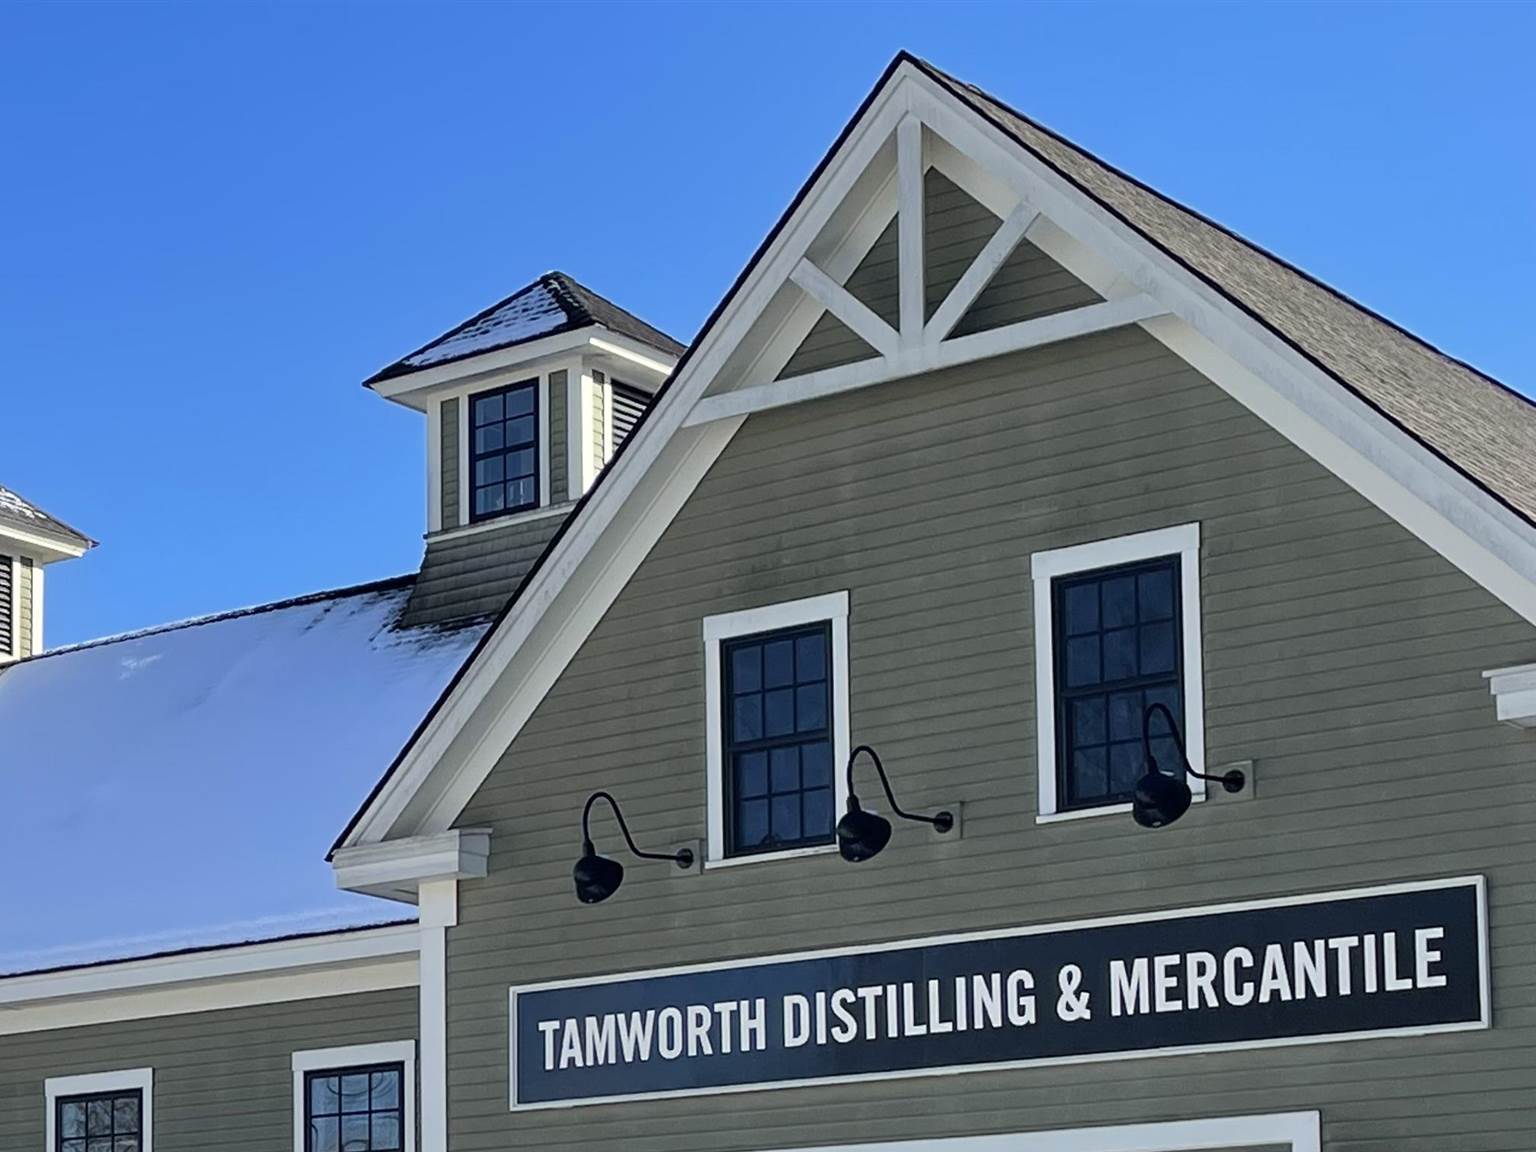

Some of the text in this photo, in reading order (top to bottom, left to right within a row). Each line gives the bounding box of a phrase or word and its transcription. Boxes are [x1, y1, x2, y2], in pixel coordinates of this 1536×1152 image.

[538, 926, 1448, 1070] TAMWORTH DISTILLING & MERCANTILE
